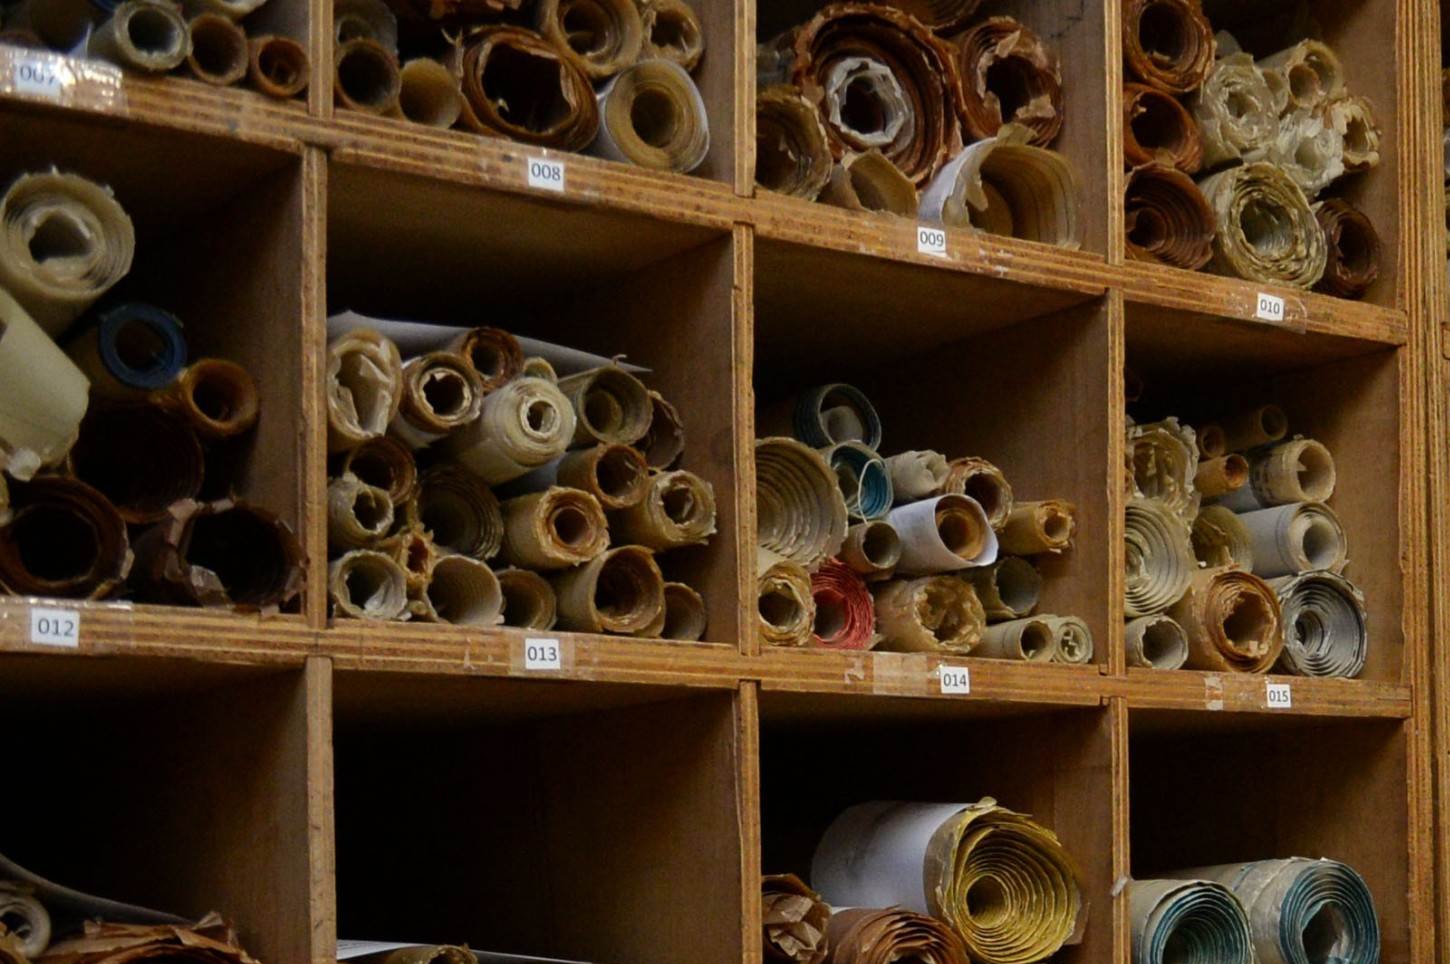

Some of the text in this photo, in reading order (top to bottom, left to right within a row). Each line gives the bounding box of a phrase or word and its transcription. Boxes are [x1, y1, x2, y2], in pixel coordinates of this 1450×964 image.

[531, 163, 560, 181] 008
[920, 231, 944, 247] 009
[1260, 299, 1280, 314] 010
[38, 618, 75, 637] 012
[527, 646, 557, 661] 013
[943, 673, 967, 687] 014
[1269, 690, 1289, 702] 015
